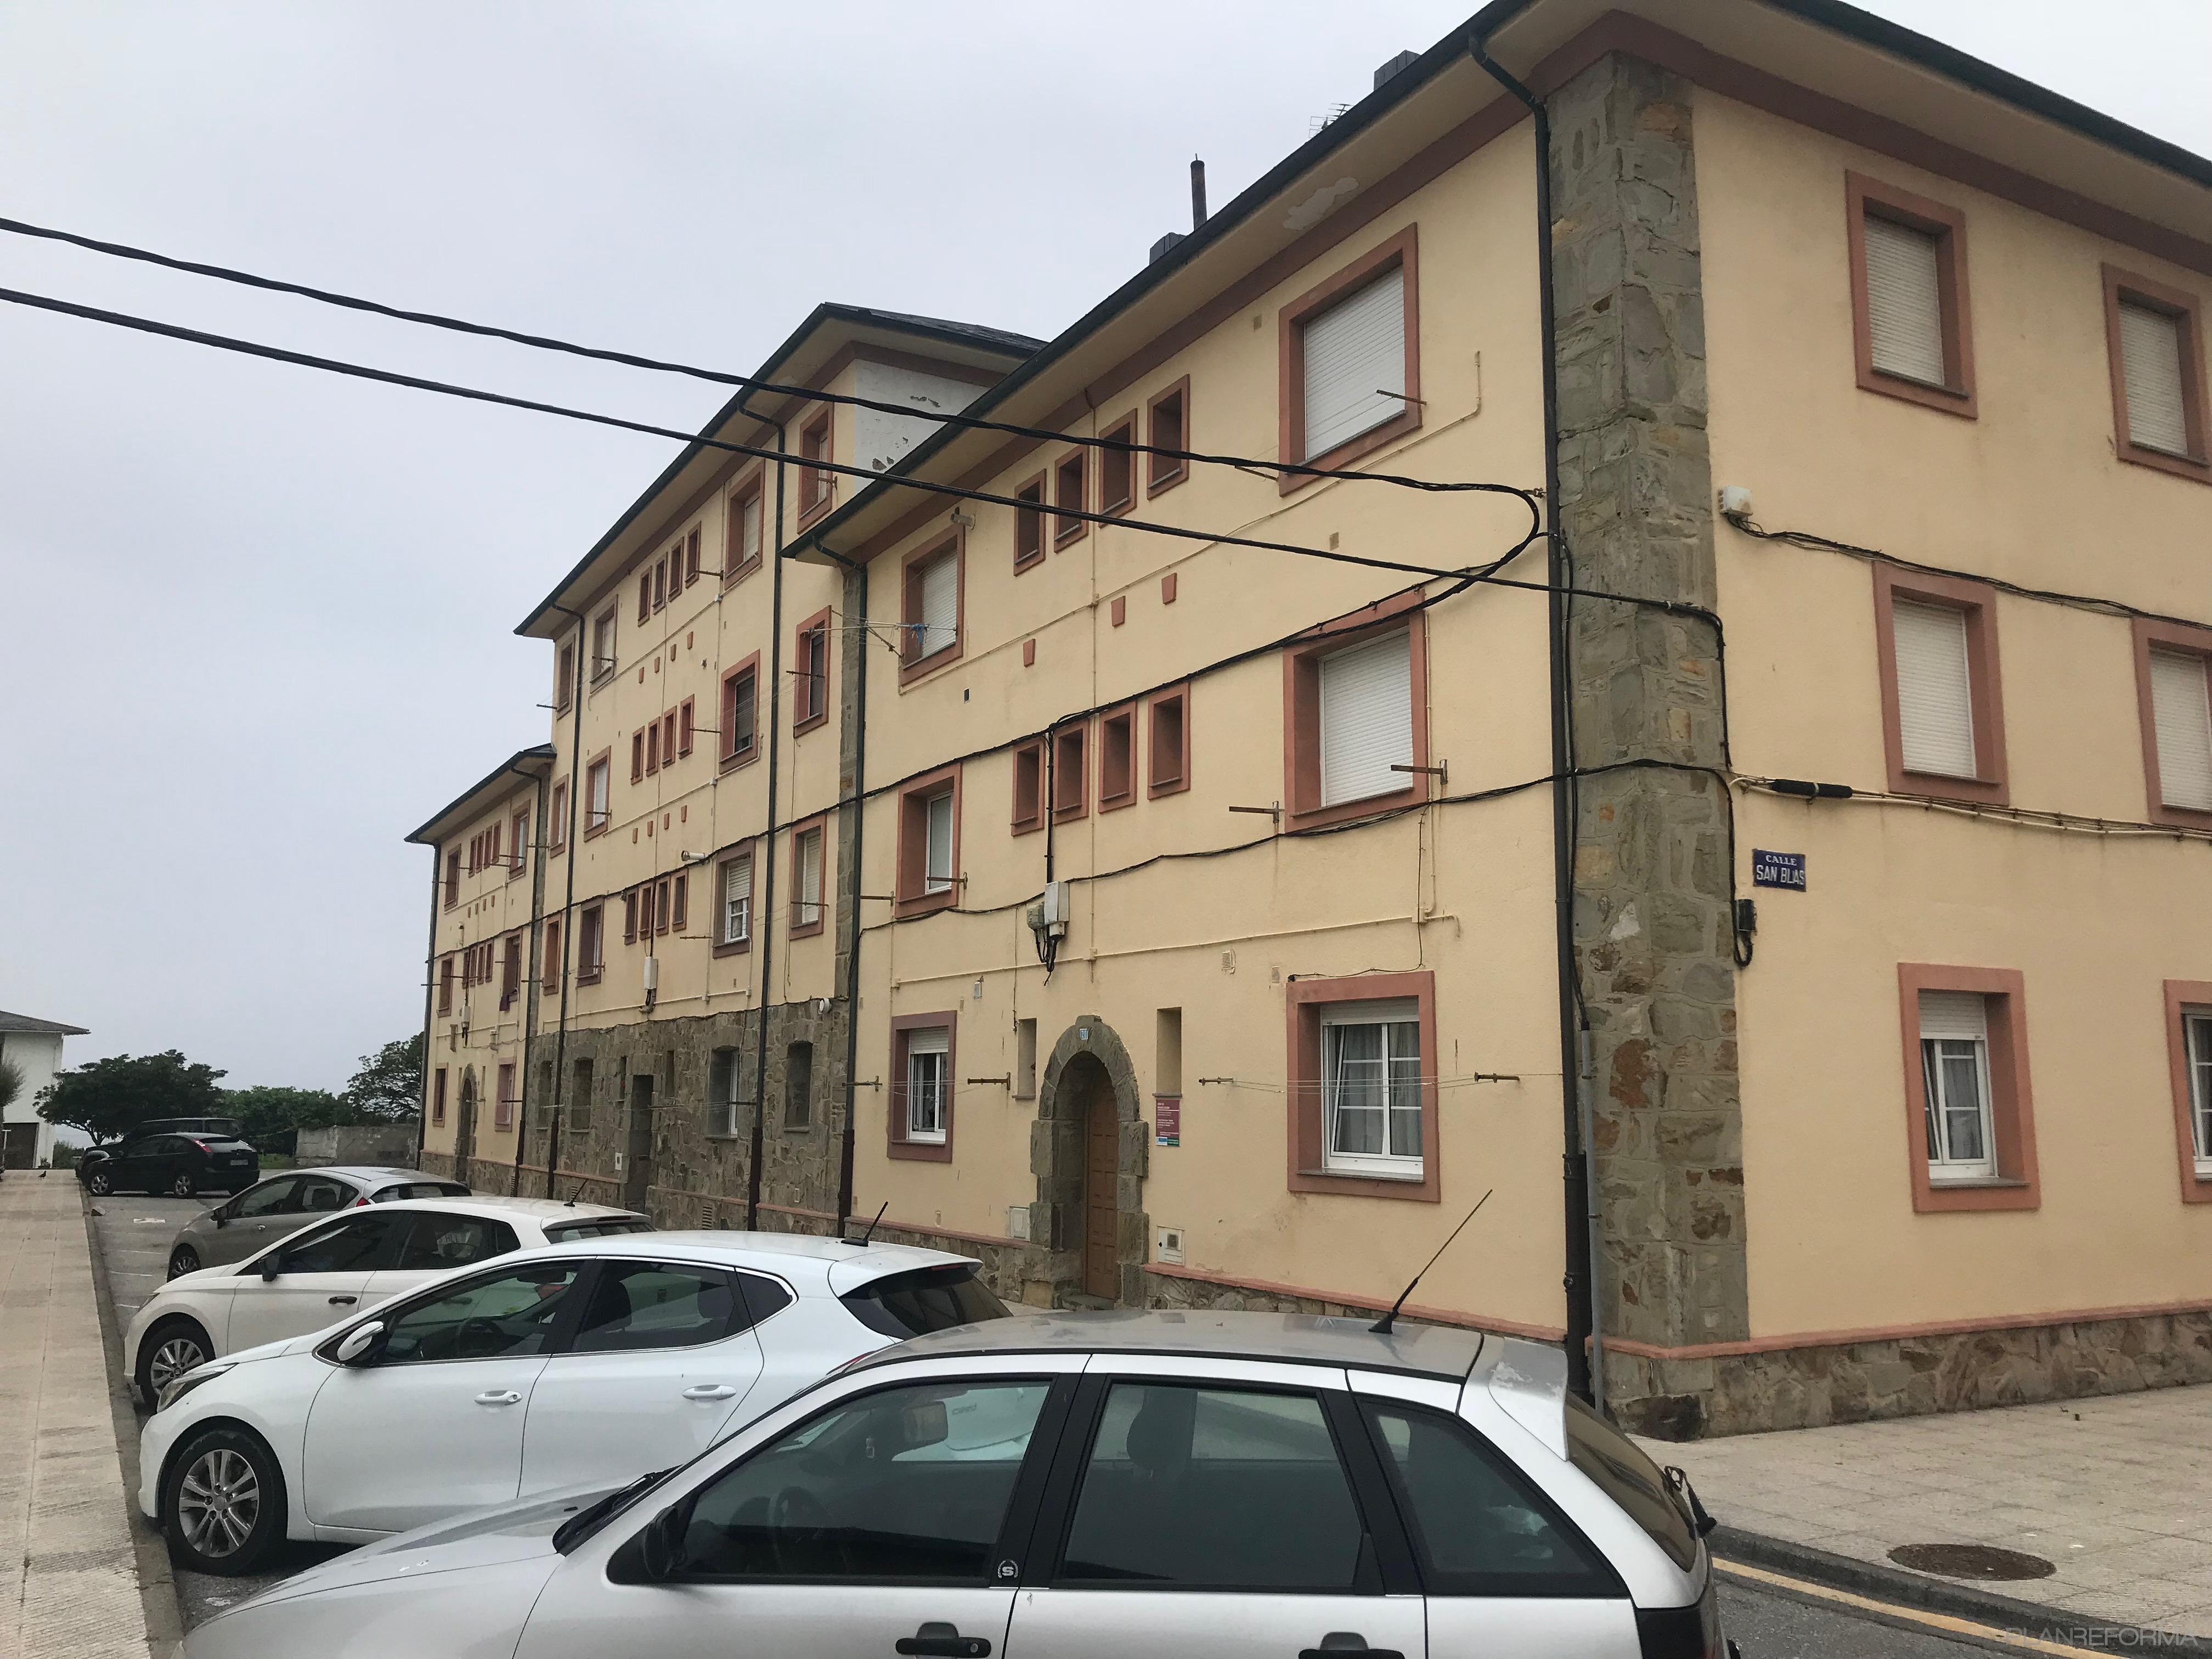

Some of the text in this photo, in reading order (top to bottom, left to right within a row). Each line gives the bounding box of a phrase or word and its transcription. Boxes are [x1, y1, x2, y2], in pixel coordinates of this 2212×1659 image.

[1765, 855, 1797, 866] CALLE
[1756, 865, 1805, 885] SAN BLAS
